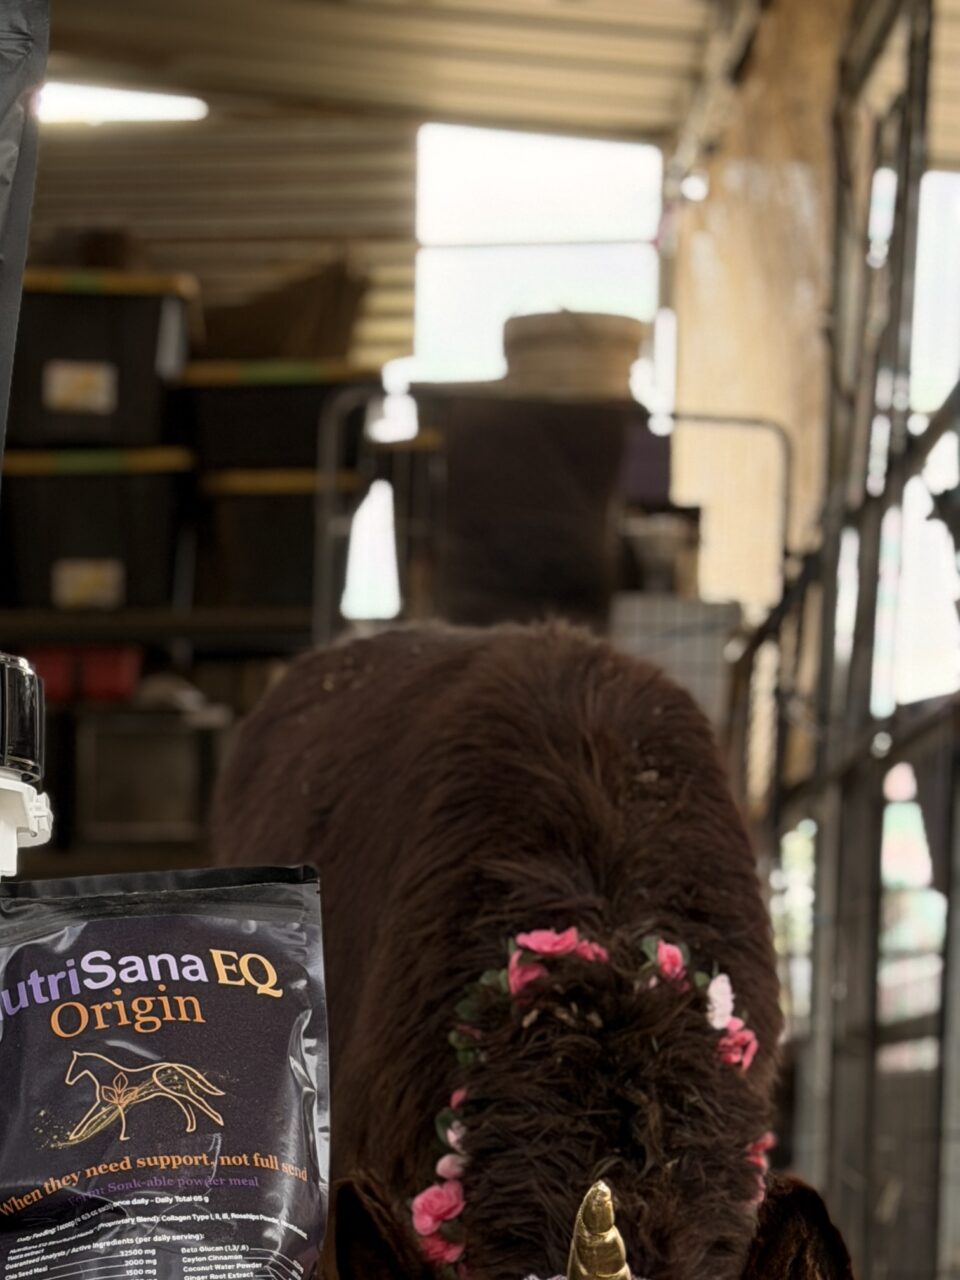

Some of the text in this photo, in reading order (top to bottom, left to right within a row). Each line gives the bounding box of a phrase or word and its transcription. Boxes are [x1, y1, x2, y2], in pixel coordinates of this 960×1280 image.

[210, 949, 283, 998] EQ
[50, 984, 205, 1040] Origin
[43, 1172, 81, 1196] they
[85, 1156, 132, 1178] need
[136, 1153, 214, 1169] support,
[219, 1153, 250, 1167] not
[252, 1152, 279, 1169] full
[281, 1161, 308, 1182] send
[107, 1176, 174, 1192] Soak-able
[228, 1176, 259, 1186] meal
[132, 1197, 149, 1207] daily
[155, 1196, 173, 1204] Daily
[175, 1195, 192, 1203] Total
